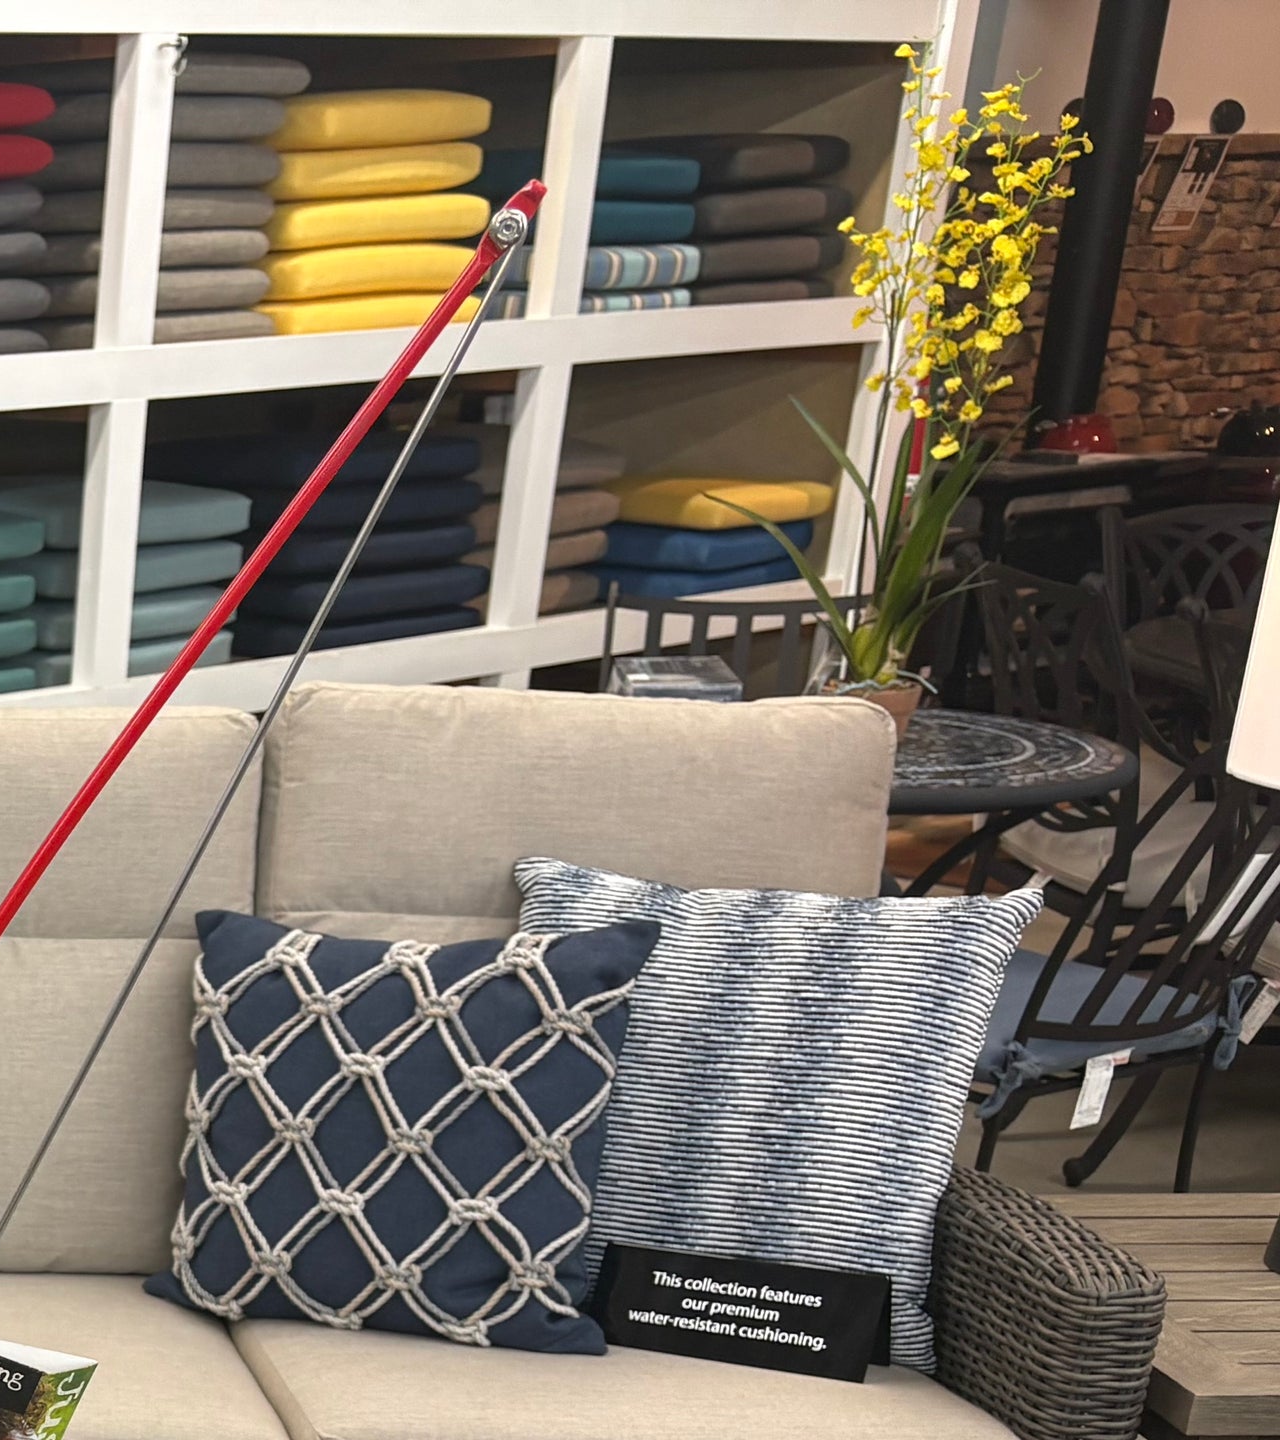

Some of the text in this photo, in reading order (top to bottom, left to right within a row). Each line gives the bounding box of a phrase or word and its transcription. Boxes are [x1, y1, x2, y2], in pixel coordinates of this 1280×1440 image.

[652, 1270, 823, 1308] This collection features
[681, 1298, 780, 1322] our premium
[628, 1309, 827, 1352] water-resistant cushioning.
